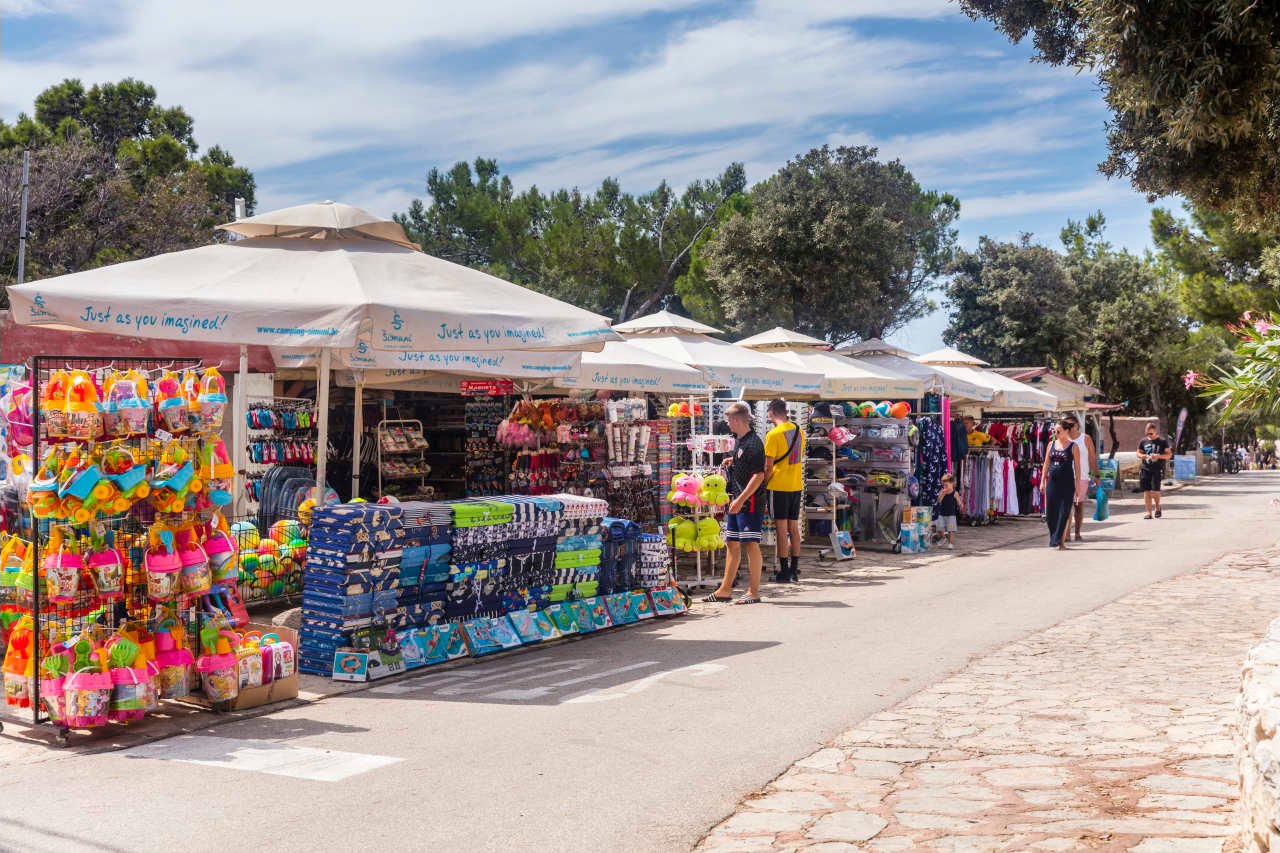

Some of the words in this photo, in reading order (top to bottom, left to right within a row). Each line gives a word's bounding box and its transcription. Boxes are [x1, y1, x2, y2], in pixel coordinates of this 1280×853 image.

[80, 305, 111, 323] Just
[116, 313, 132, 324] as
[135, 315, 158, 330] you
[161, 312, 229, 334] imagined!
[437, 322, 464, 339] Just
[468, 329, 481, 339] as
[484, 330, 501, 343] you
[504, 325, 546, 343] imagined!
[398, 351, 425, 362] Just
[429, 354, 441, 363] as
[444, 355, 460, 366] you
[461, 354, 505, 369] imagined!
